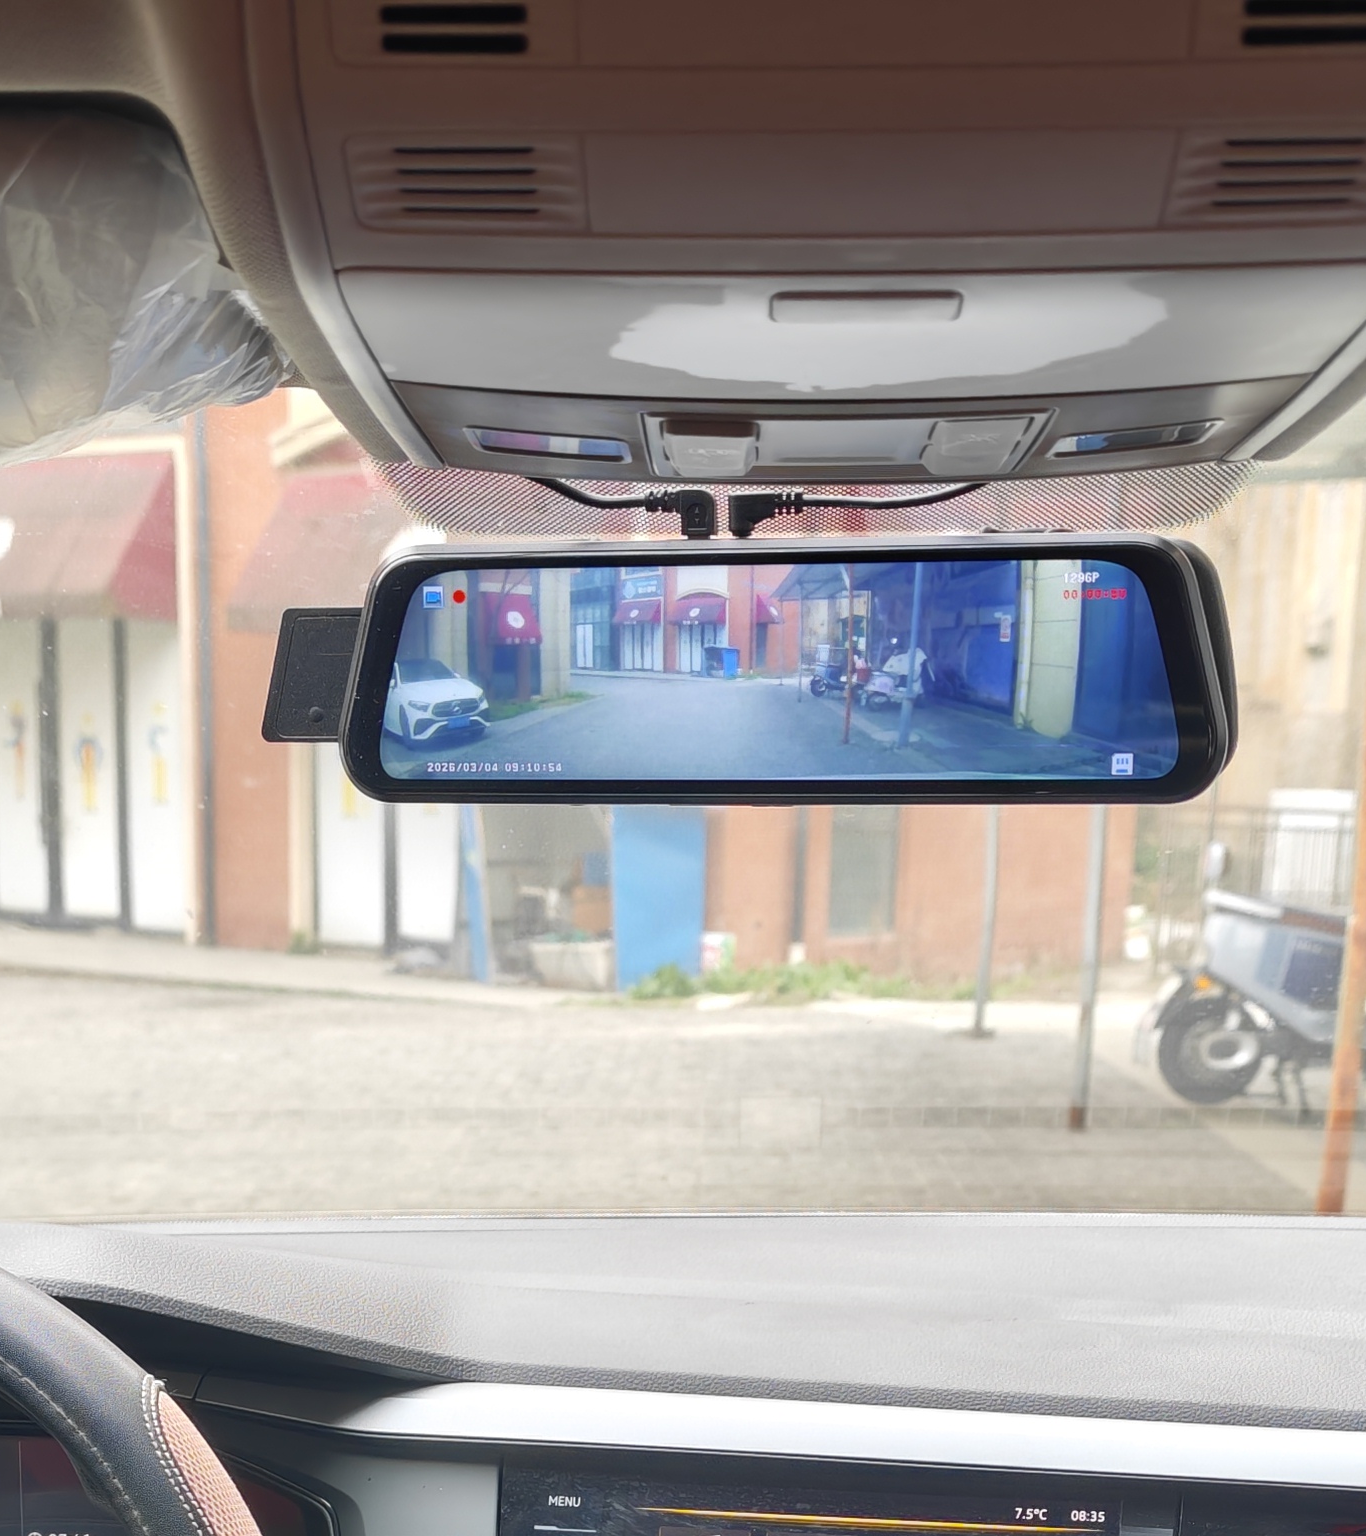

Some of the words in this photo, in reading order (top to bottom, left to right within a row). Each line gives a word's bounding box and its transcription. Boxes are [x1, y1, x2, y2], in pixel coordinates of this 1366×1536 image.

[1063, 572, 1100, 583] 1296P
[427, 762, 499, 772] 2026/03/04
[504, 762, 562, 772] 09:10:54
[548, 1495, 581, 1507] MENU
[1070, 1510, 1105, 1522] 08:35
